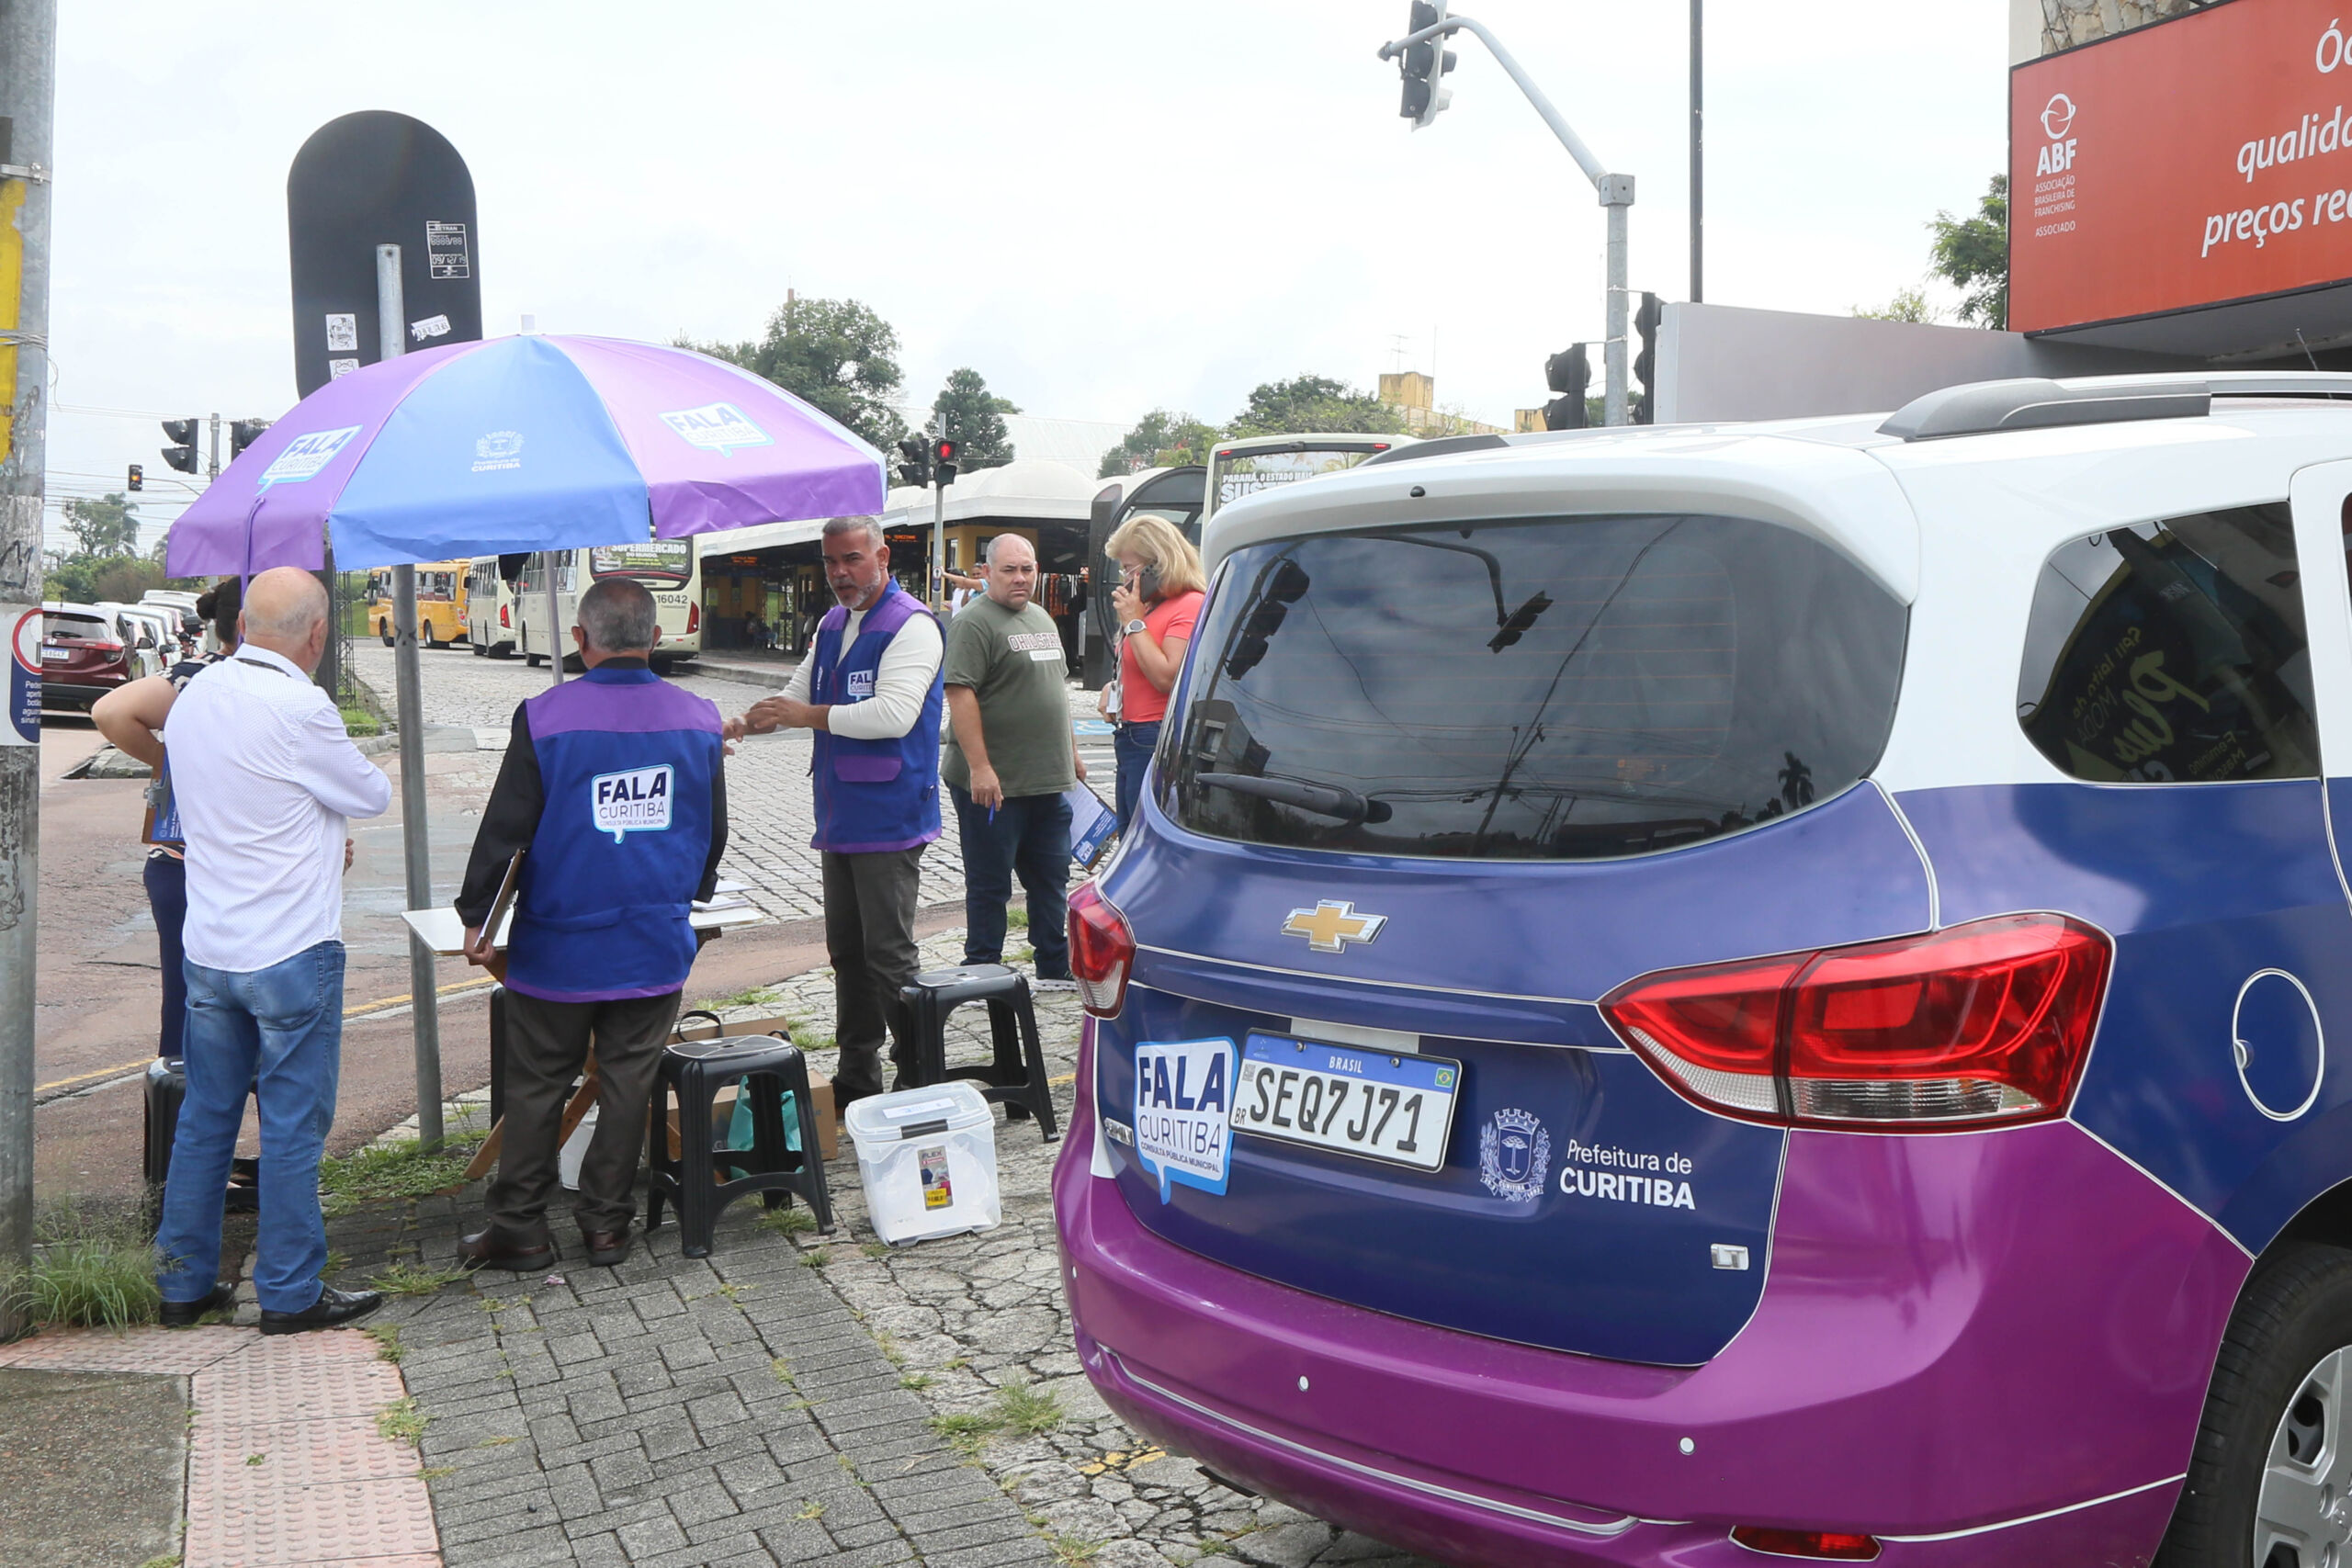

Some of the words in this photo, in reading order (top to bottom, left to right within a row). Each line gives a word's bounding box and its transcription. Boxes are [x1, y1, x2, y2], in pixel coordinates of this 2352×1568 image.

[2036, 139, 2077, 176] ABF
[2034, 175, 2075, 194] ASSOCIAÇÃO
[2034, 190, 2065, 207] BRASILEIRA
[2066, 188, 2075, 198] DE
[2034, 200, 2075, 218] FRANCHISING
[2035, 220, 2075, 238] ASSOCIADO
[2201, 198, 2305, 258] preços
[2312, 189, 2352, 226] re
[666, 407, 743, 432] FALA
[282, 431, 354, 459] FALA
[471, 463, 521, 472] CURITIBA
[1223, 472, 1259, 483] PARANÁ,
[1260, 474, 1265, 482] O
[1266, 472, 1294, 481] ESTADO
[611, 543, 687, 555] SUPERMERCADO
[657, 594, 688, 604] 16042
[1009, 634, 1037, 650] OHIO
[850, 673, 872, 684] FAL
[598, 772, 667, 805] FALA
[599, 800, 666, 819] CURITIBA
[1329, 1055, 1363, 1074] BRASIL
[1138, 1052, 1226, 1113] FALA
[1234, 1107, 1247, 1125] BR
[1250, 1066, 1424, 1153] SEQ7J71
[1138, 1114, 1221, 1158] CURITIBA
[1141, 1141, 1165, 1156] CONSULTA
[1166, 1148, 1188, 1164] PÚBLICA
[1189, 1156, 1220, 1173] MUNICIPAL
[1566, 1139, 1660, 1171] Prefeitura
[1665, 1152, 1693, 1176] de
[1559, 1167, 1697, 1211] CURITIBA
[1711, 1244, 1748, 1270] LT
